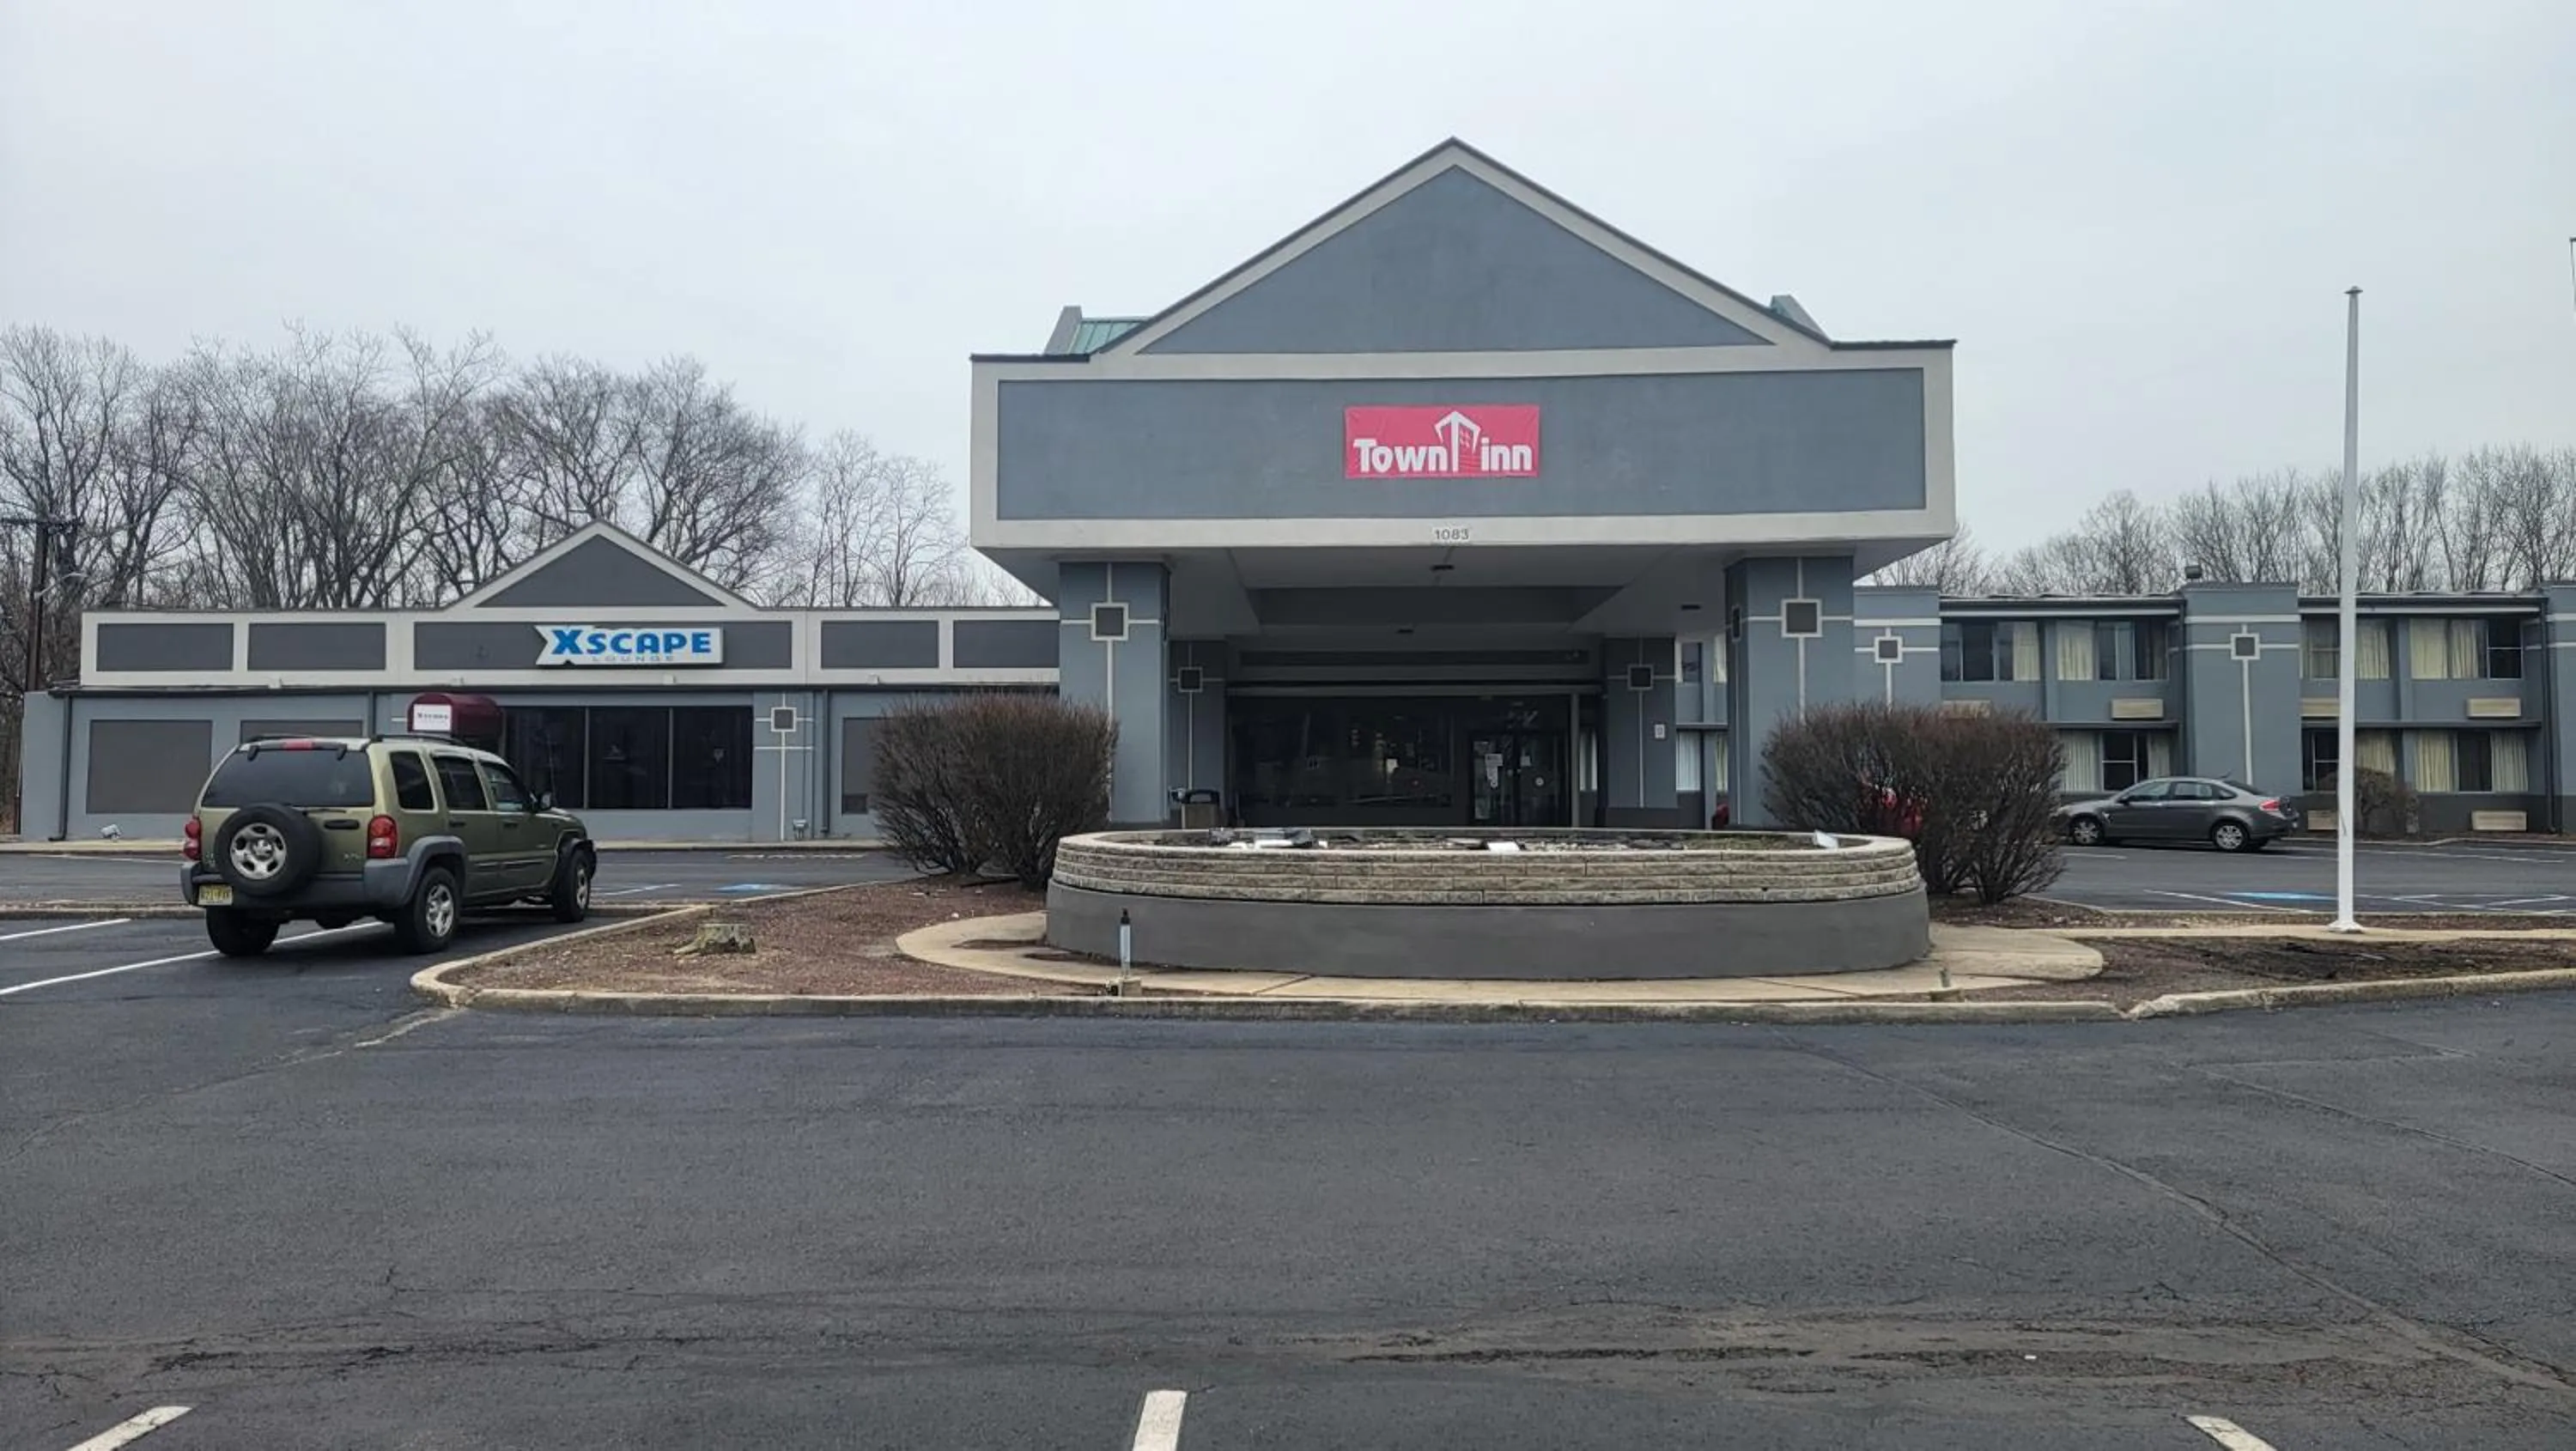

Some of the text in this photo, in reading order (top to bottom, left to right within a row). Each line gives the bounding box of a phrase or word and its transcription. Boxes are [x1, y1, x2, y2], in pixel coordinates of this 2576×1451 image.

[1353, 437, 1533, 472] Town inn
[1434, 529, 1469, 540] 1083
[551, 629, 712, 655] XSCAPE
